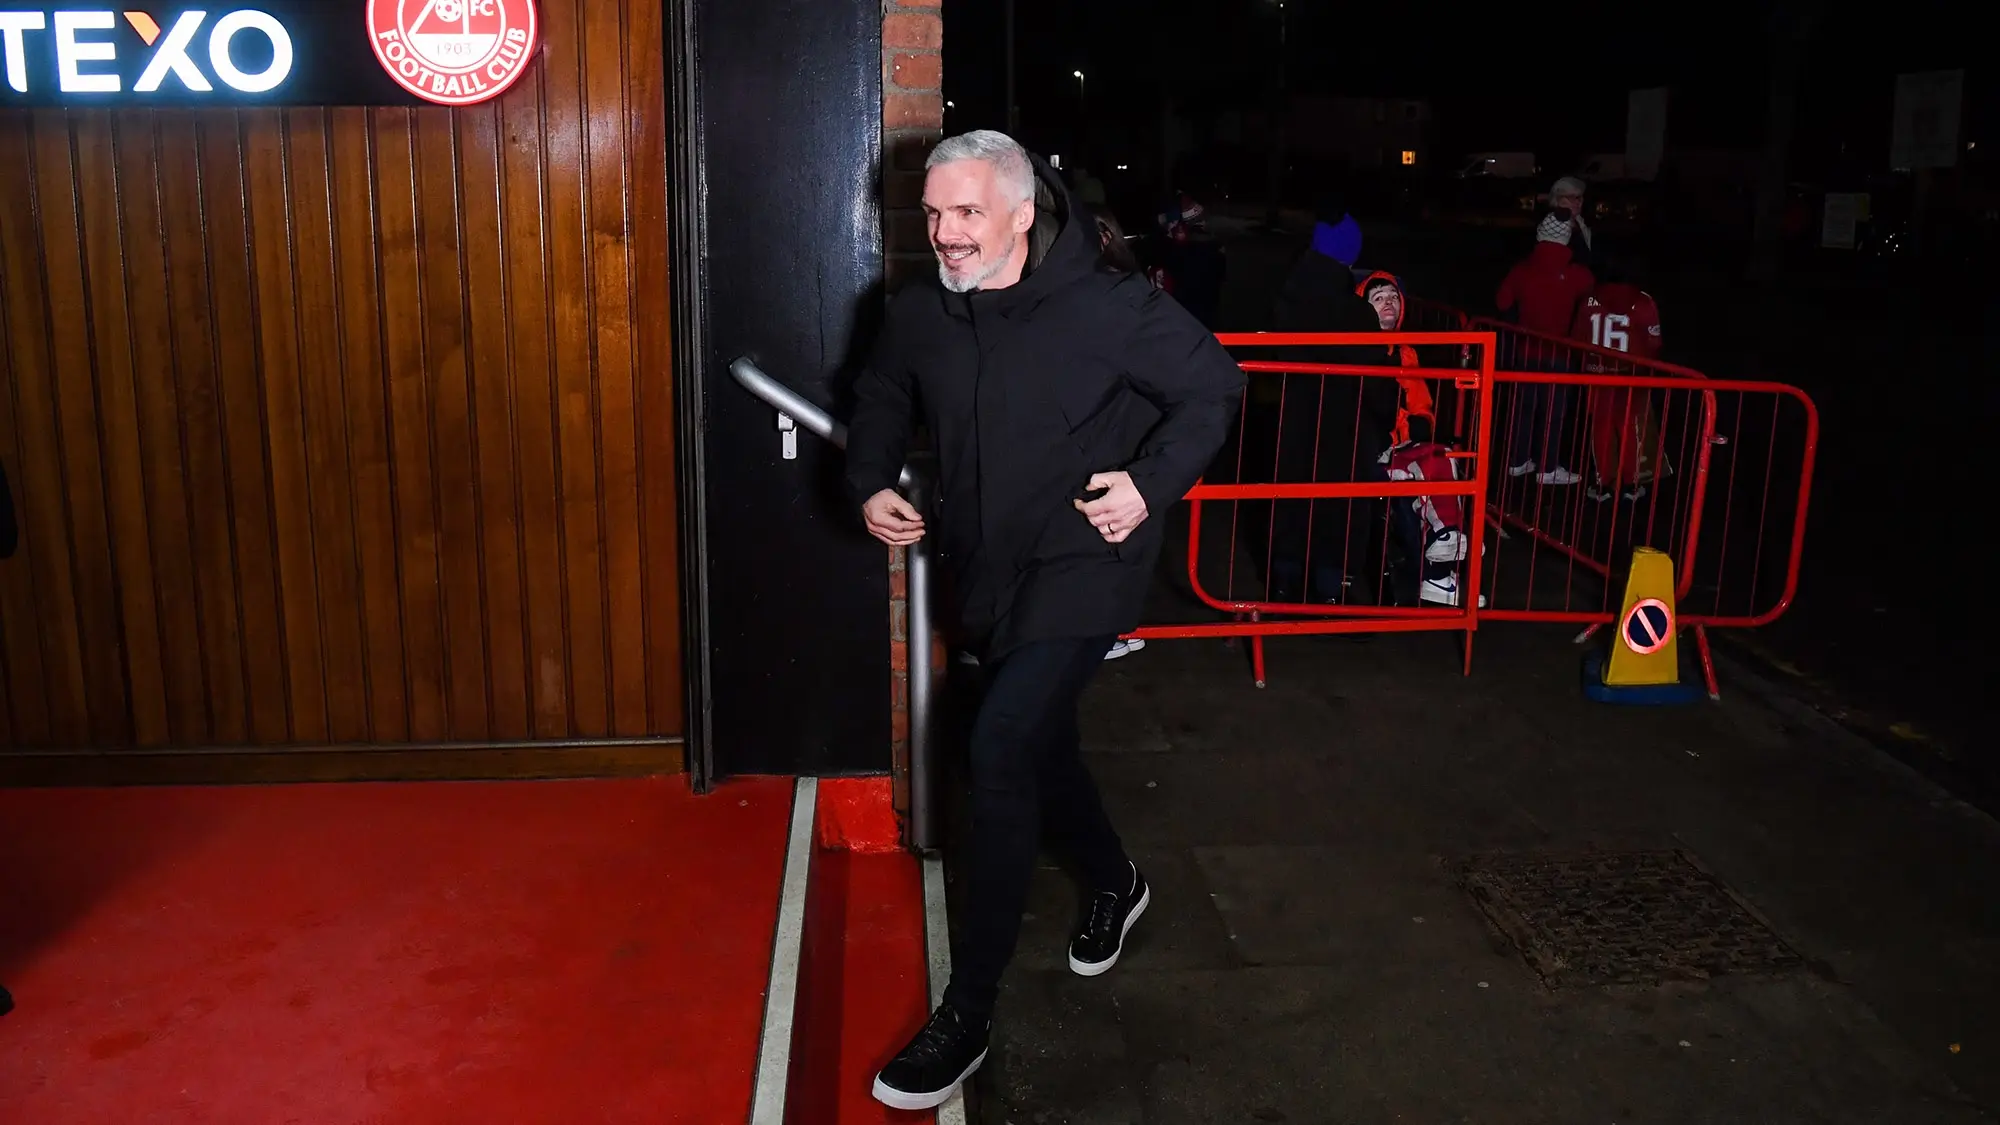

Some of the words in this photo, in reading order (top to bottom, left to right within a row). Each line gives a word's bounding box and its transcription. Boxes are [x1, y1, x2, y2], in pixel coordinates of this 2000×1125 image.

[470, 0, 494, 17] FC
[0, 9, 293, 92] TEXO
[378, 29, 487, 95] FOOTBALL
[486, 27, 527, 81] CLUB
[436, 42, 472, 57] 1903
[1589, 312, 1630, 352] 16
